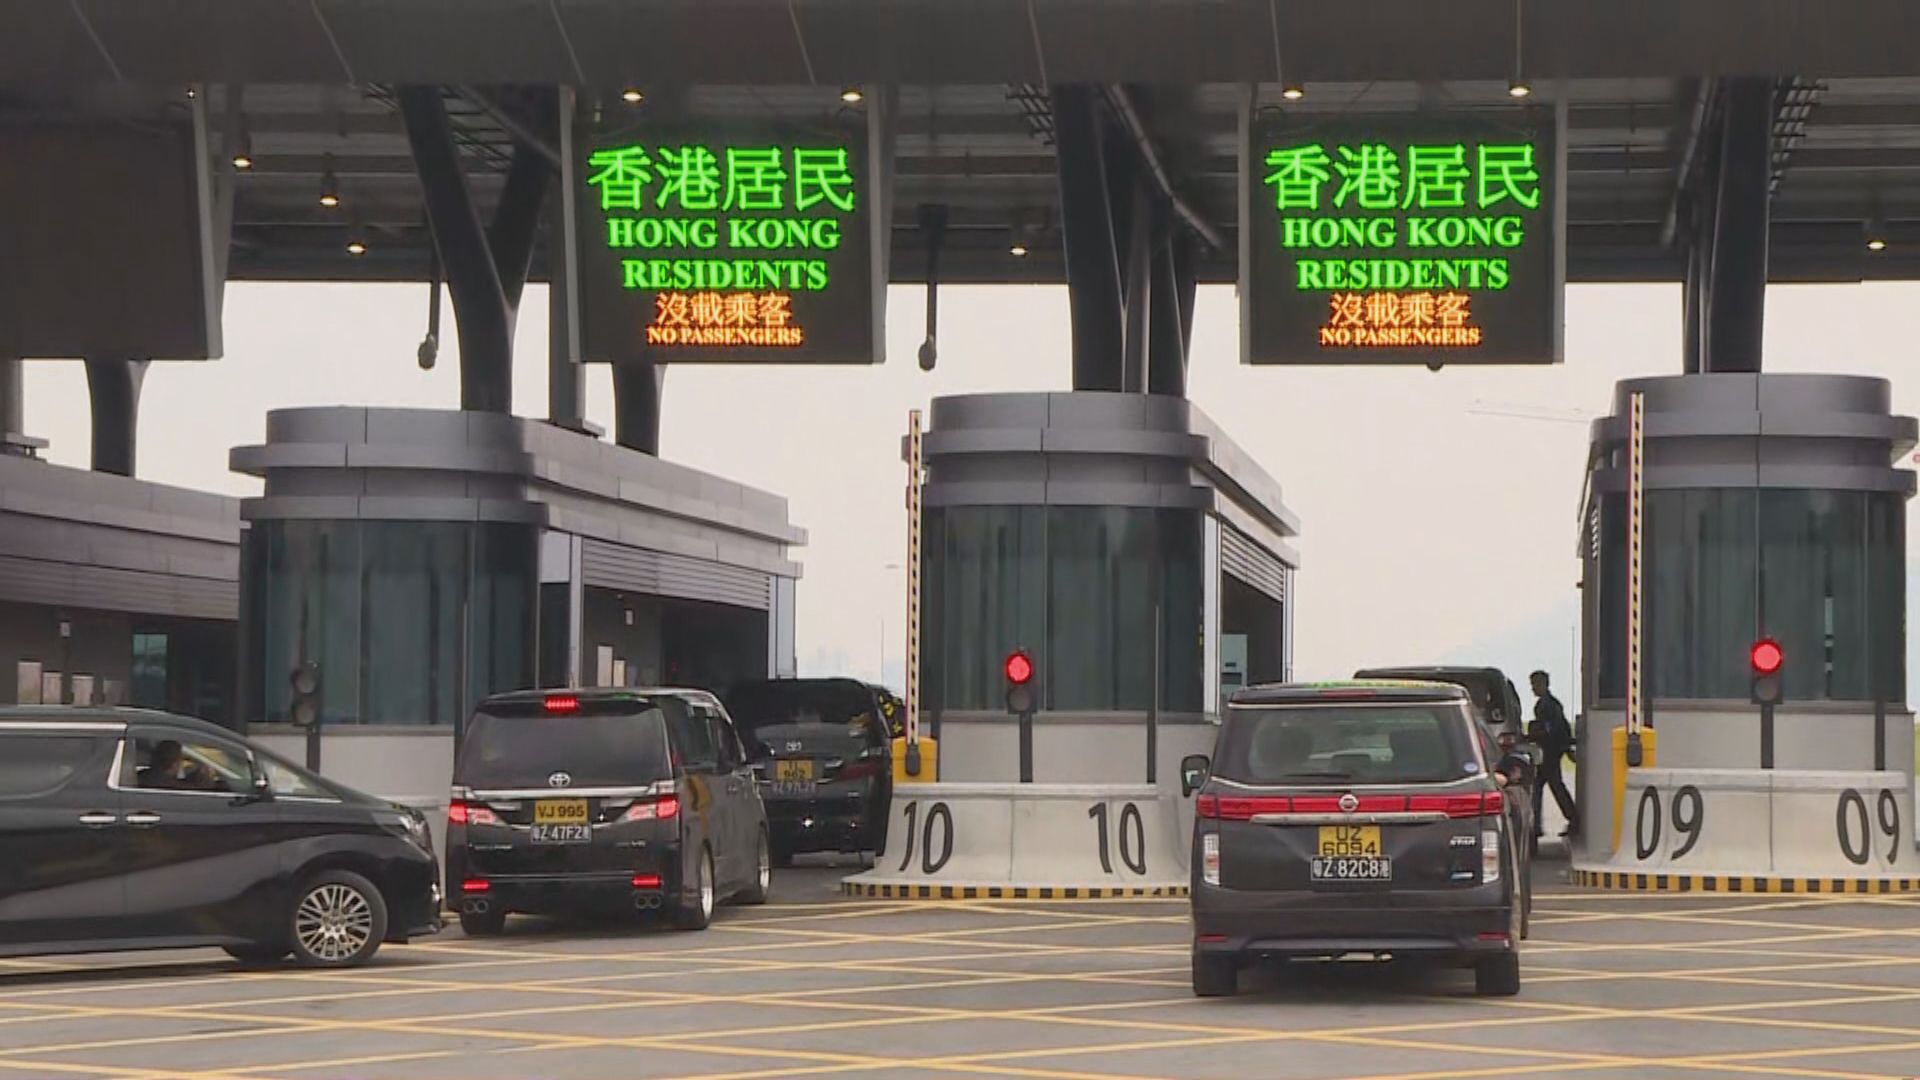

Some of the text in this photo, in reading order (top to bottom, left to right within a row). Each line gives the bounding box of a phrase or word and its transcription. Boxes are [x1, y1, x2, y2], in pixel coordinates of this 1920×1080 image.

[588, 146, 855, 211] 香港居民
[1264, 145, 1540, 209] 香港居民
[607, 219, 840, 248] HONG KONG
[1282, 217, 1523, 247] HONG KONG
[622, 260, 828, 289] RESIDENTS
[1296, 260, 1509, 289] RESIDENTS
[648, 328, 802, 345] NO PASSENGERS
[1321, 328, 1480, 345] NO PASSENGERS
[537, 806, 585, 818] VJ 995
[1636, 785, 1704, 861] 09
[1836, 788, 1900, 865] 09
[898, 801, 954, 875] 10
[1088, 802, 1147, 876] 10
[1336, 825, 1363, 841] UZ
[1322, 841, 1377, 855] 6094
